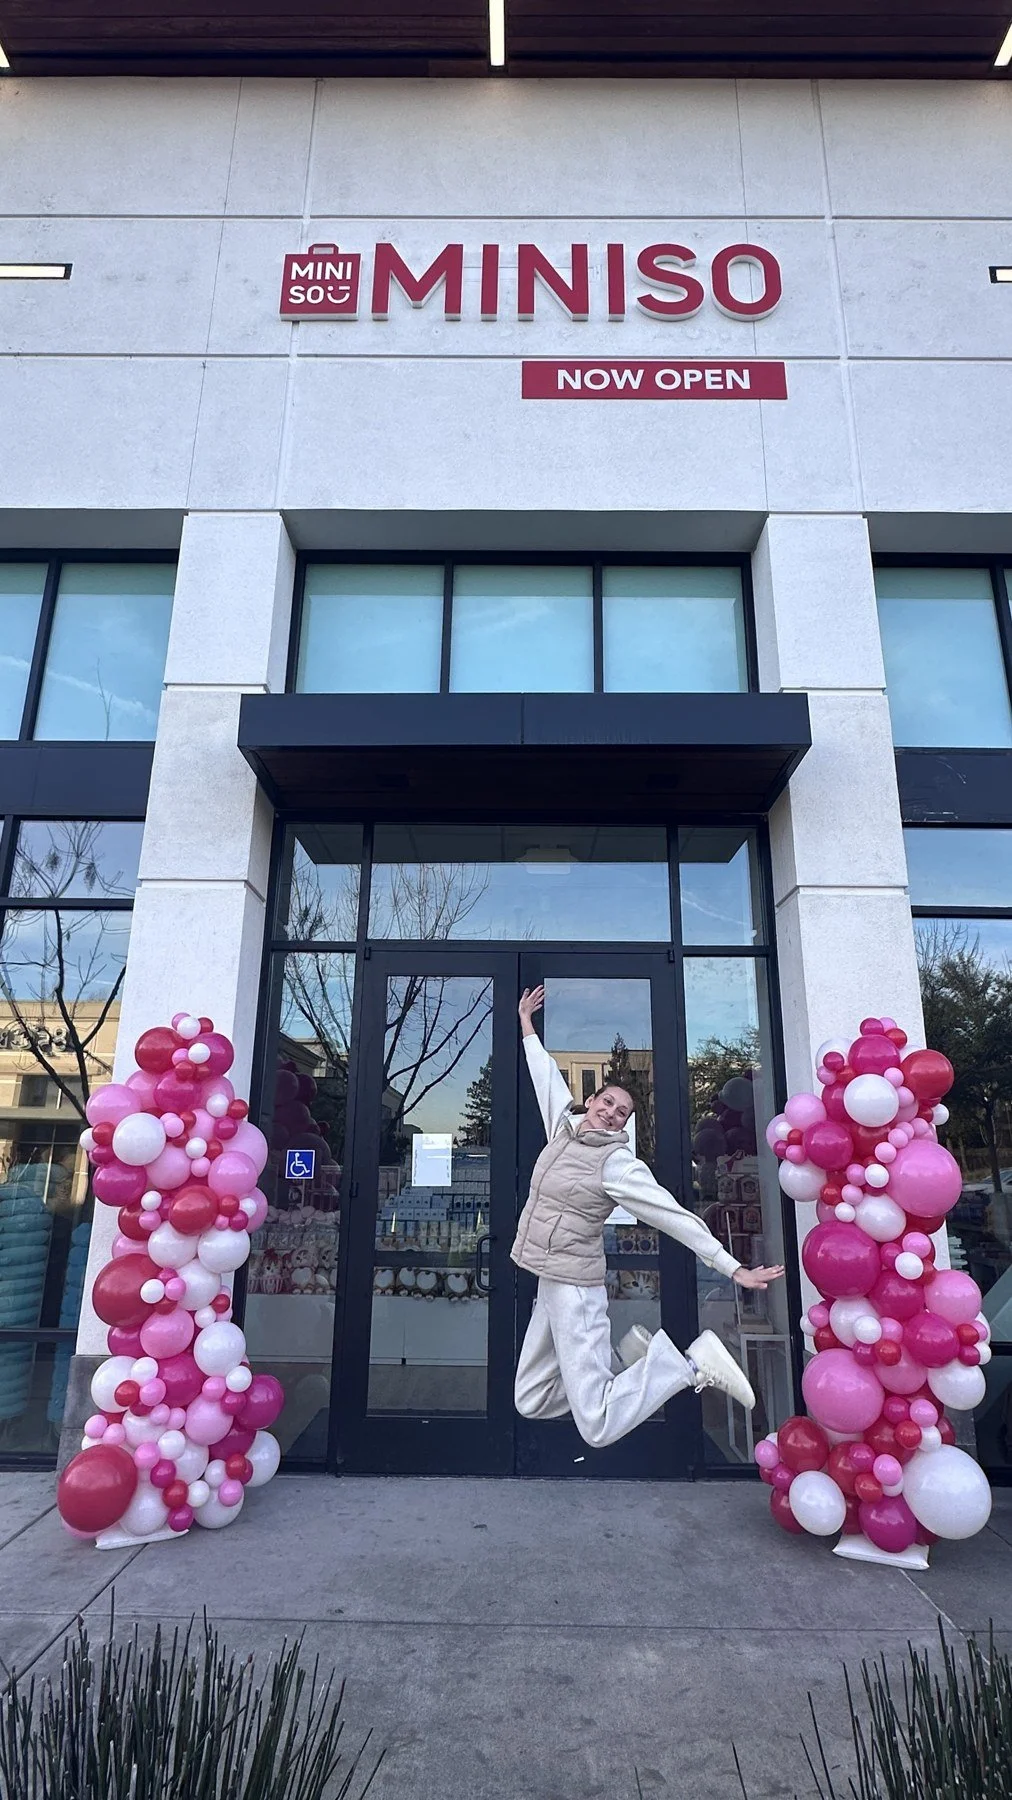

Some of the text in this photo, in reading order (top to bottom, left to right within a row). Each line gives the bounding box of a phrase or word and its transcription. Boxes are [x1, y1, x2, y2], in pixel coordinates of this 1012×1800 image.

[290, 261, 353, 281] MINI
[373, 243, 782, 317] MINISO
[288, 285, 325, 305] SO
[557, 368, 751, 391] NOW OPEN
